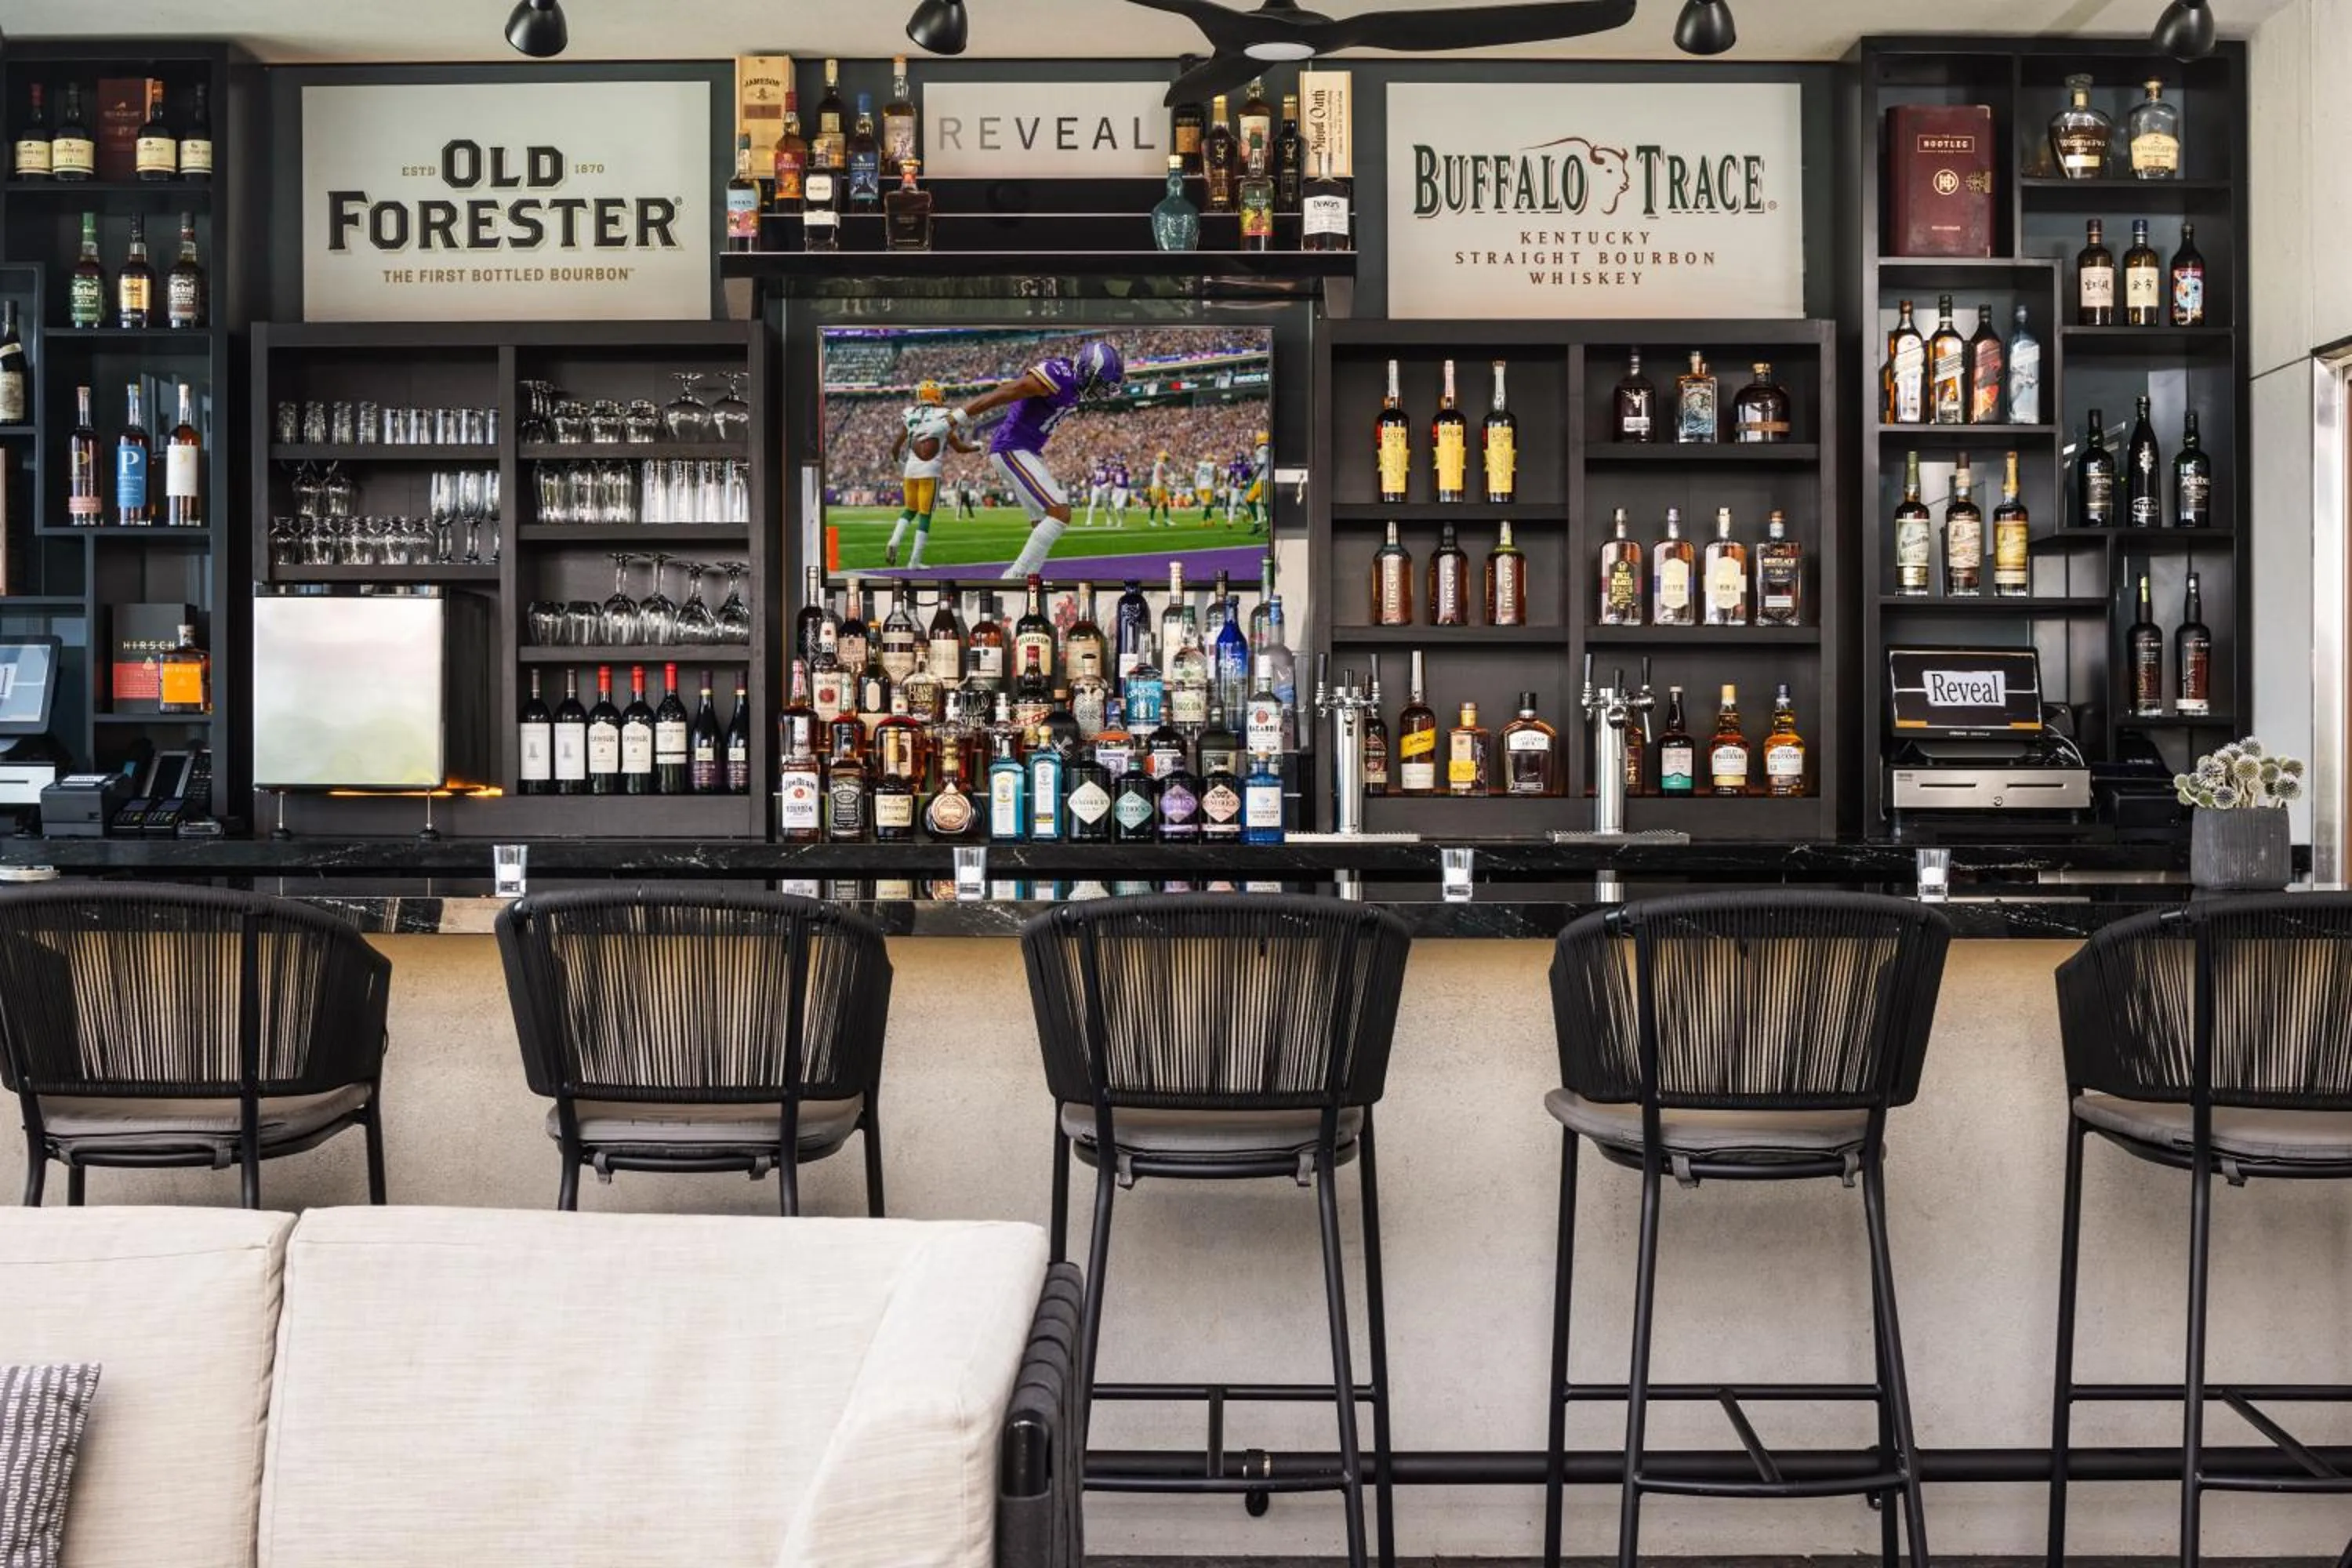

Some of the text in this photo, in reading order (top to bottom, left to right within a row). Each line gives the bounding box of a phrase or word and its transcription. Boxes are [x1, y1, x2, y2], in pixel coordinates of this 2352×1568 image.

[939, 116, 1156, 151] REVEAL
[441, 139, 566, 189] OLD
[575, 163, 605, 174] 1870
[1413, 144, 1766, 219] BUFFALO TRACE
[327, 190, 679, 251] FORESTER
[1520, 230, 1652, 245] KENTUCKY
[1454, 251, 1717, 266] STRAIGHT BOURBON
[383, 267, 629, 284] THE FIRST BOTTLED BOURBON
[1529, 271, 1645, 286] WHISKEY
[122, 641, 176, 650] HIRSCH
[1930, 673, 2001, 704] Reveal
